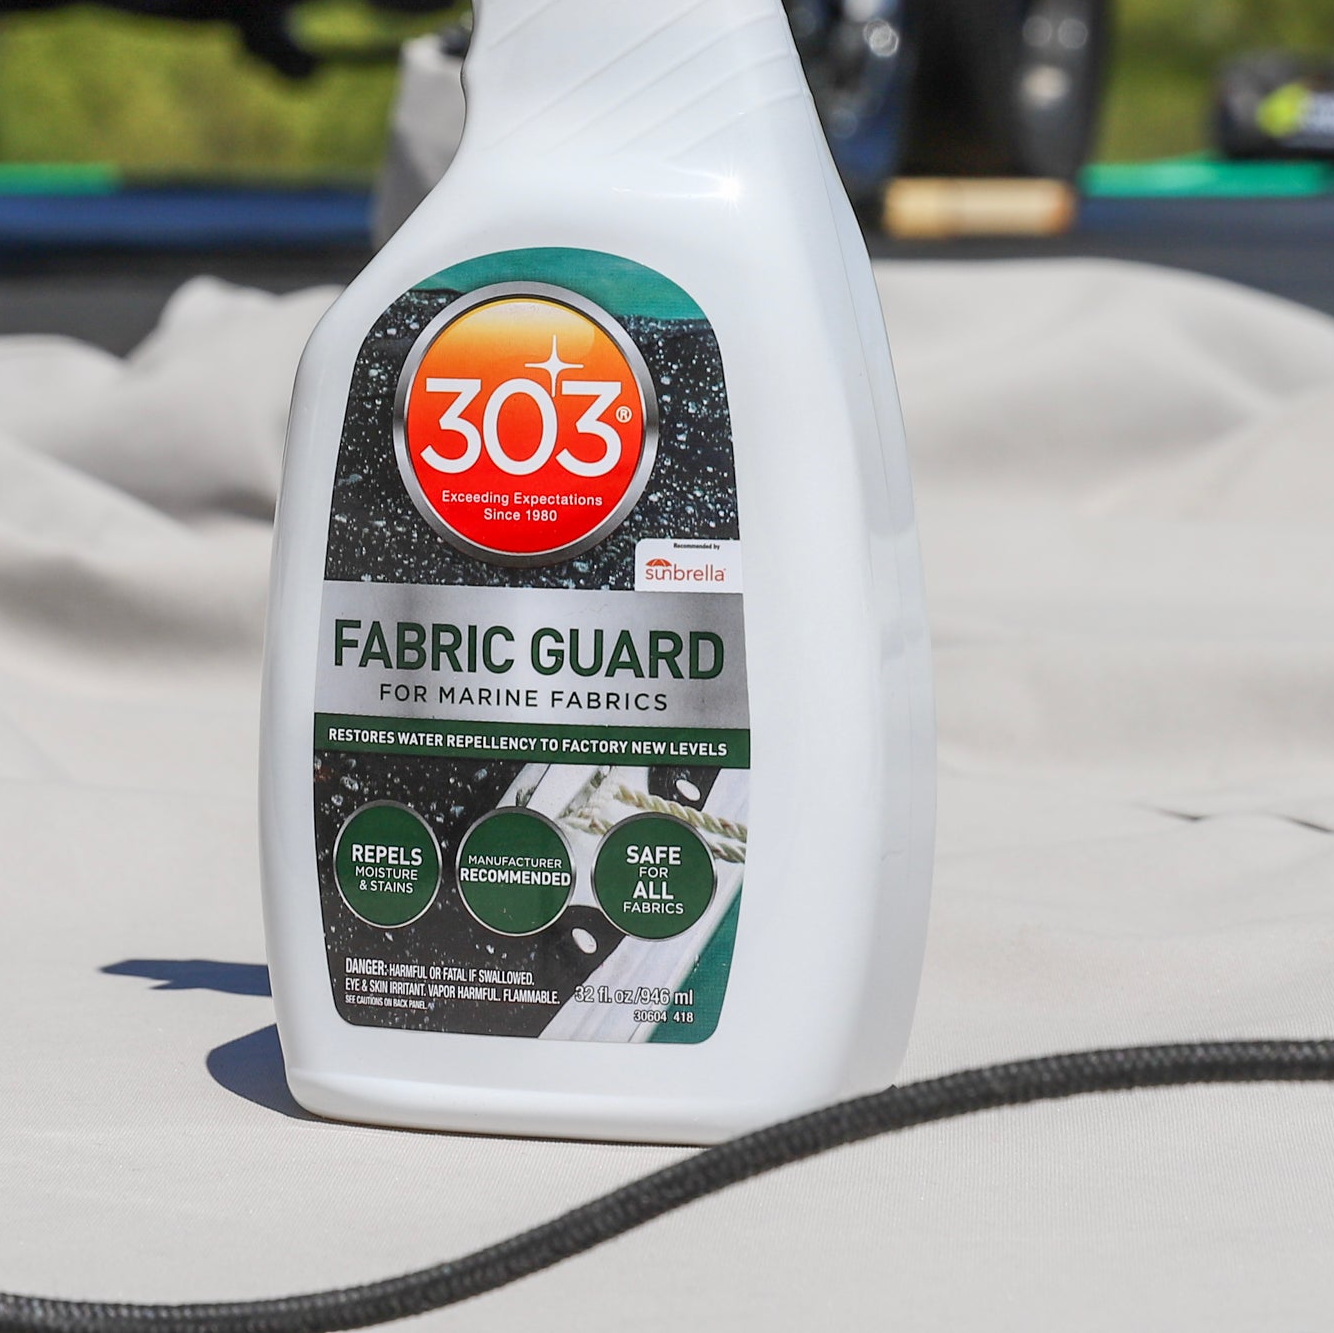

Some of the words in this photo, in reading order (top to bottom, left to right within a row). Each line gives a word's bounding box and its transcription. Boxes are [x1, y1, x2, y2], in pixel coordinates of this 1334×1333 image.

[442, 490, 509, 506] Exceeding
[513, 492, 603, 506] Expectations
[483, 509, 520, 521] Since
[526, 510, 557, 522] 1980
[334, 619, 515, 673] FABRIC
[530, 627, 725, 680] GUARD
[380, 684, 427, 703] FOR
[439, 686, 538, 707] MARINE
[551, 690, 668, 711] FABRICS
[329, 728, 395, 744] RESTORES
[397, 732, 444, 747] WATER
[446, 734, 537, 751] REPELLENCY
[540, 738, 559, 751] TO
[562, 739, 628, 753] FACTORY
[631, 741, 666, 754] NEW
[669, 742, 727, 756] LEVELS
[351, 844, 423, 866] REPELS
[468, 855, 562, 869] MANUFACTURER
[626, 845, 681, 865] SAFE
[355, 866, 418, 880] MOISTURE
[460, 868, 571, 886] RECOMMENDED
[639, 867, 668, 878] FOR
[359, 880, 367, 891] &
[370, 881, 414, 894] STAINS
[633, 881, 674, 900] ALL
[623, 902, 684, 915] FABRICS
[345, 957, 388, 976] DANGER:
[389, 964, 427, 980] HARMFUL
[429, 969, 441, 980] OR
[443, 969, 467, 982] FATAL
[469, 970, 477, 982] IF
[479, 971, 535, 986] SWALLOWED.
[345, 978, 360, 991] EYE
[361, 979, 367, 992] &
[369, 980, 388, 994] SKIN
[389, 982, 426, 997] IRRITANT.
[427, 985, 455, 999] VAPOR
[457, 986, 501, 1002] HARMFUL.
[503, 989, 560, 1005] FLAMMABLE.
[345, 994, 356, 1004] SEE
[357, 995, 383, 1006] CAUTIONS
[384, 998, 392, 1006] ON
[393, 998, 408, 1007] BACK
[575, 986, 594, 1002] 32
[598, 986, 612, 1003] fl.
[674, 989, 693, 1005] ml
[634, 1010, 667, 1022] 30604
[673, 1011, 694, 1023] 418
